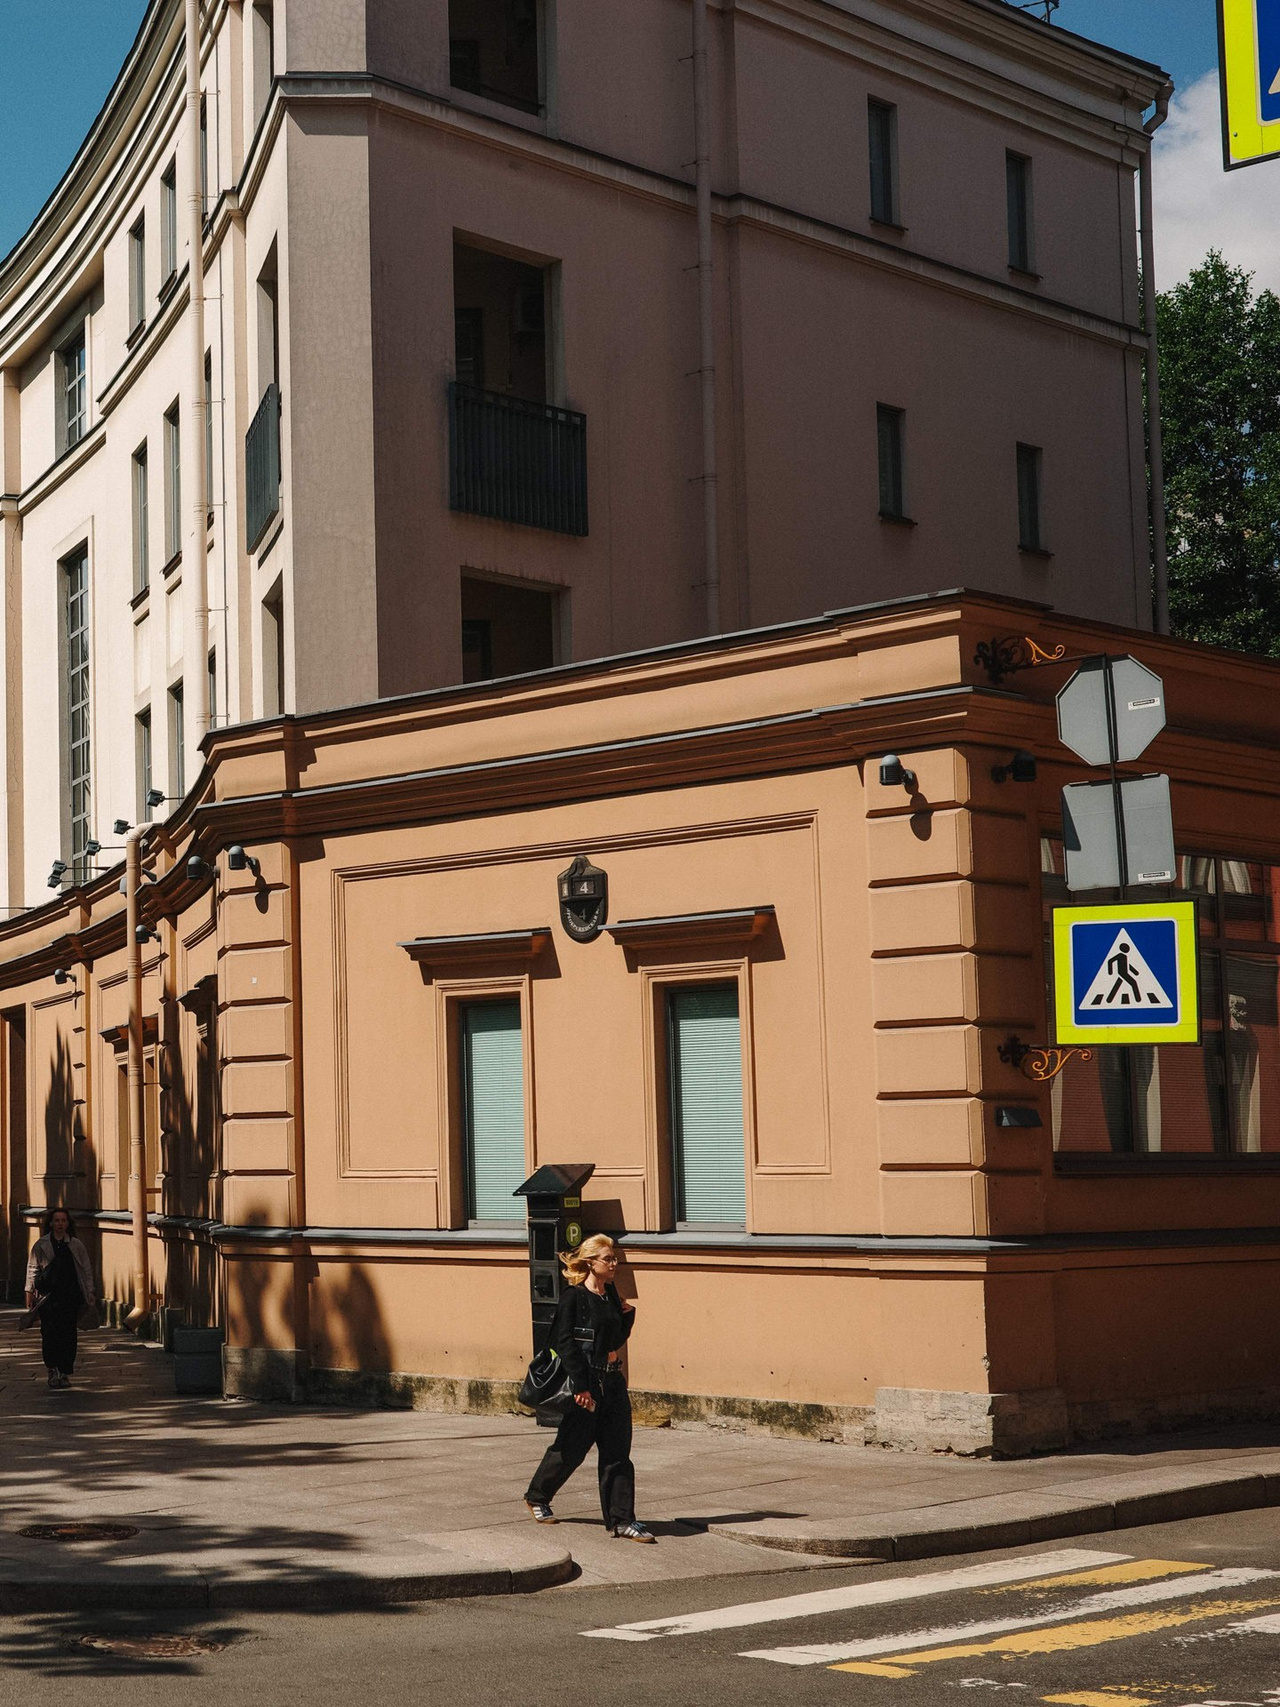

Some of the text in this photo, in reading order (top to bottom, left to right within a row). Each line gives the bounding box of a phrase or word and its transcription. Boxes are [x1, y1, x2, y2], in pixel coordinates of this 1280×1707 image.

[580, 881, 589, 894] 4
[579, 908, 587, 920] 4
[570, 1225, 579, 1242] P
